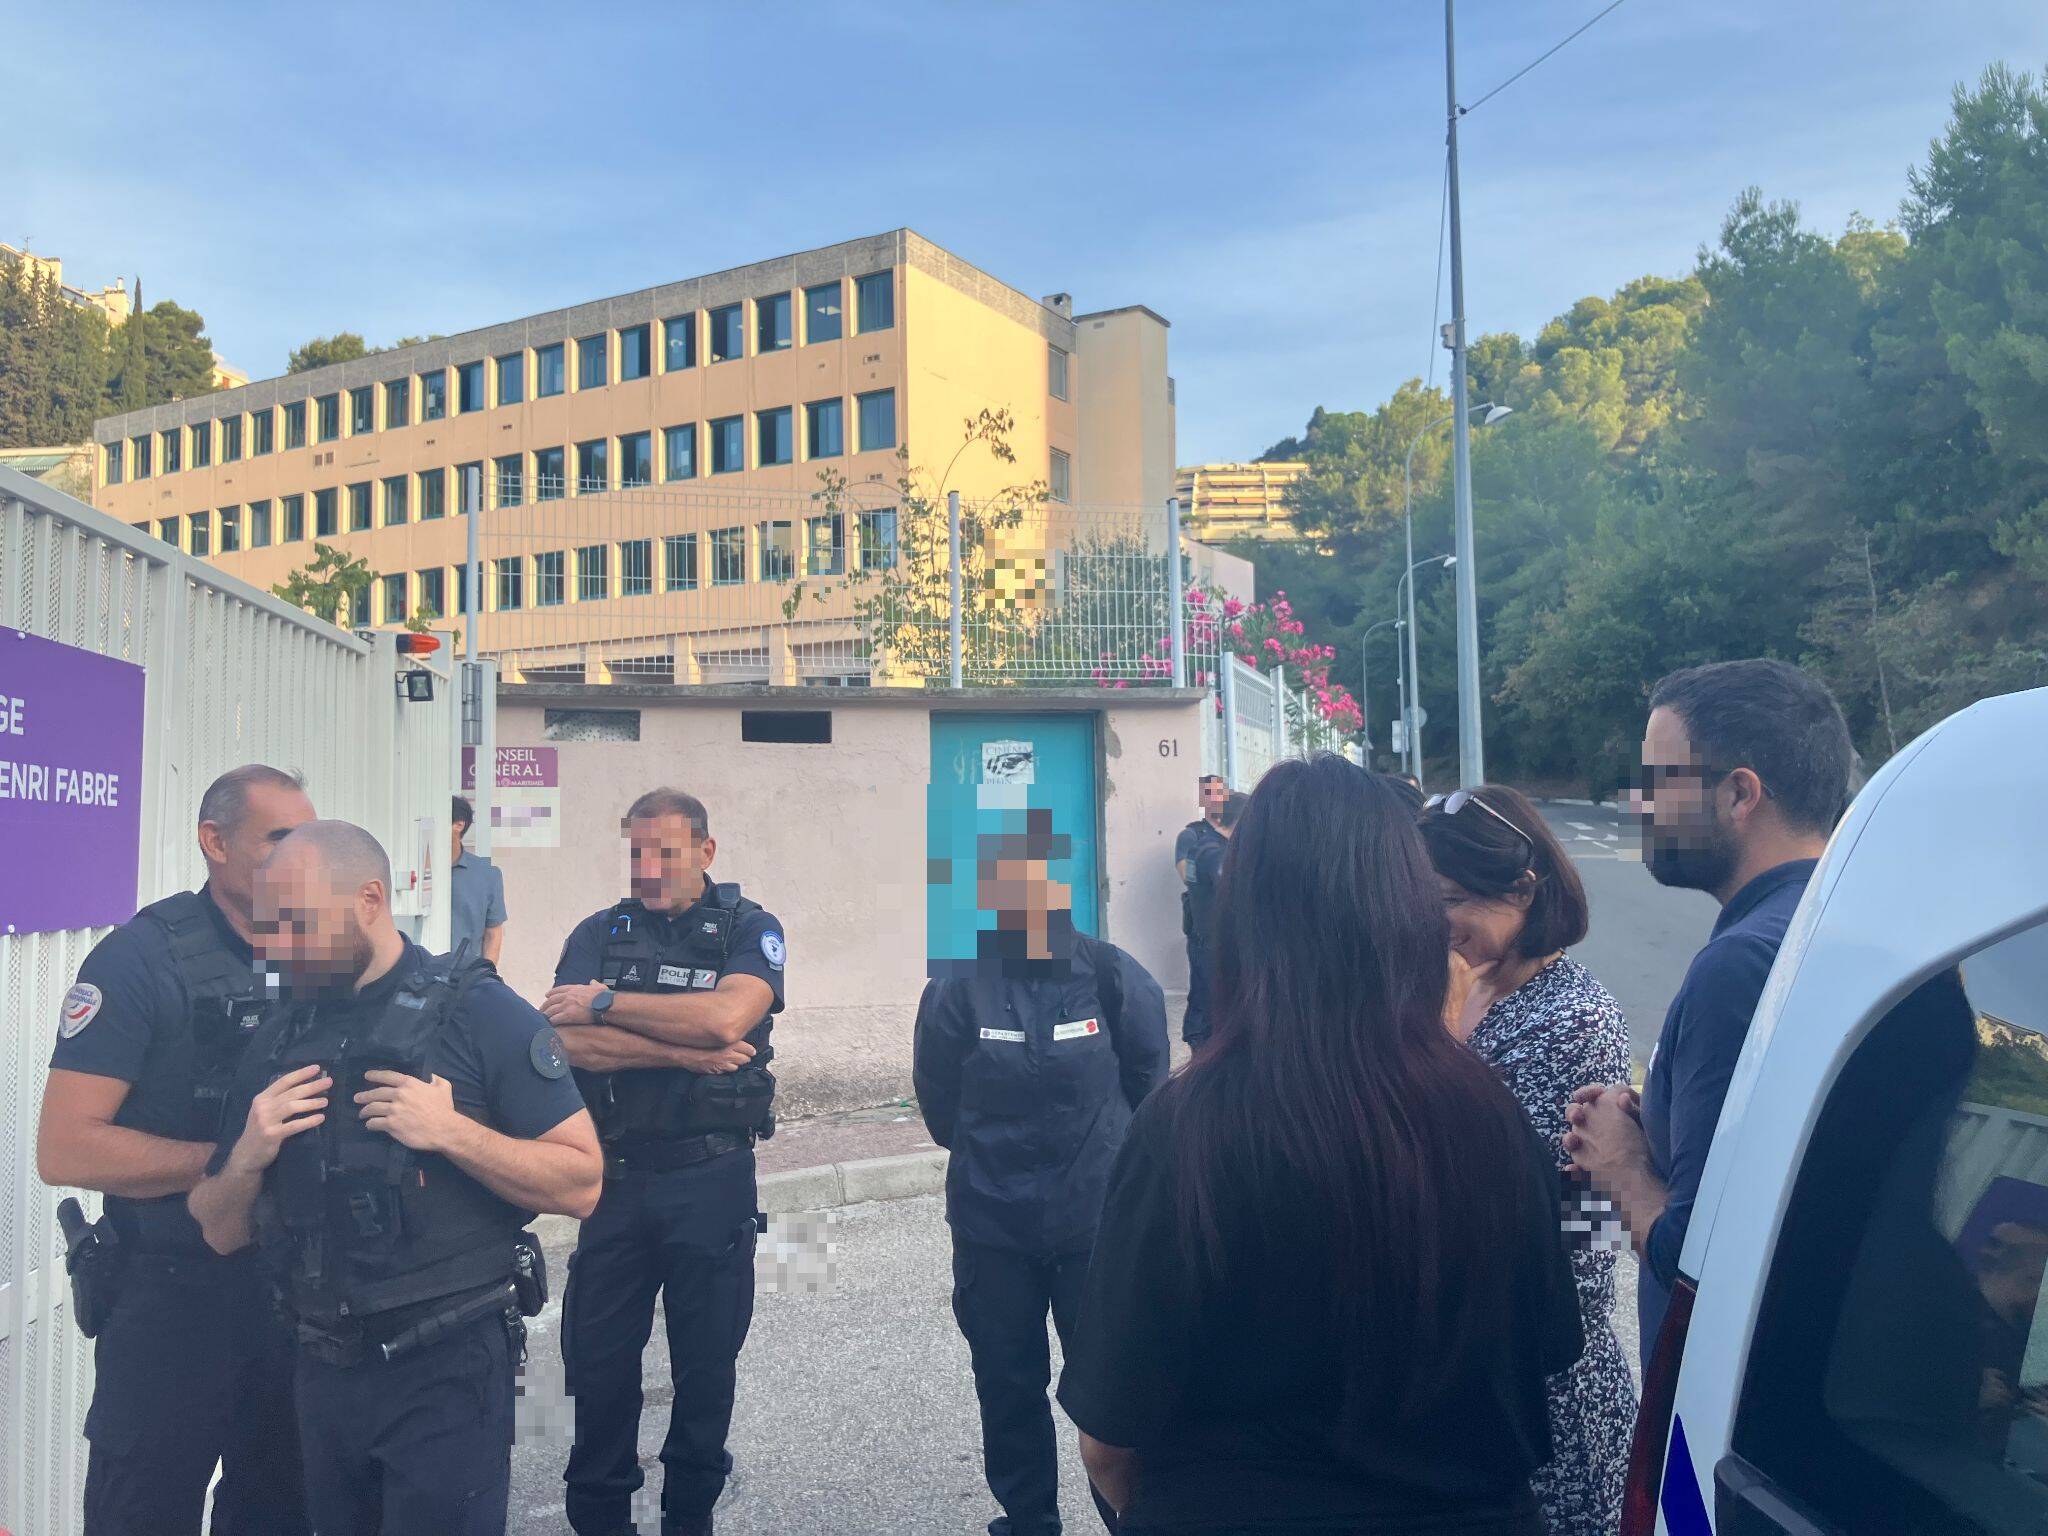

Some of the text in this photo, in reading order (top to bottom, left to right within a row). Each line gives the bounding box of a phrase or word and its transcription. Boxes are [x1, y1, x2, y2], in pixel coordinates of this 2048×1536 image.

[496, 749, 536, 761] NSEIL
[1159, 739, 1178, 756] 61
[55, 767, 119, 807] FABRE
